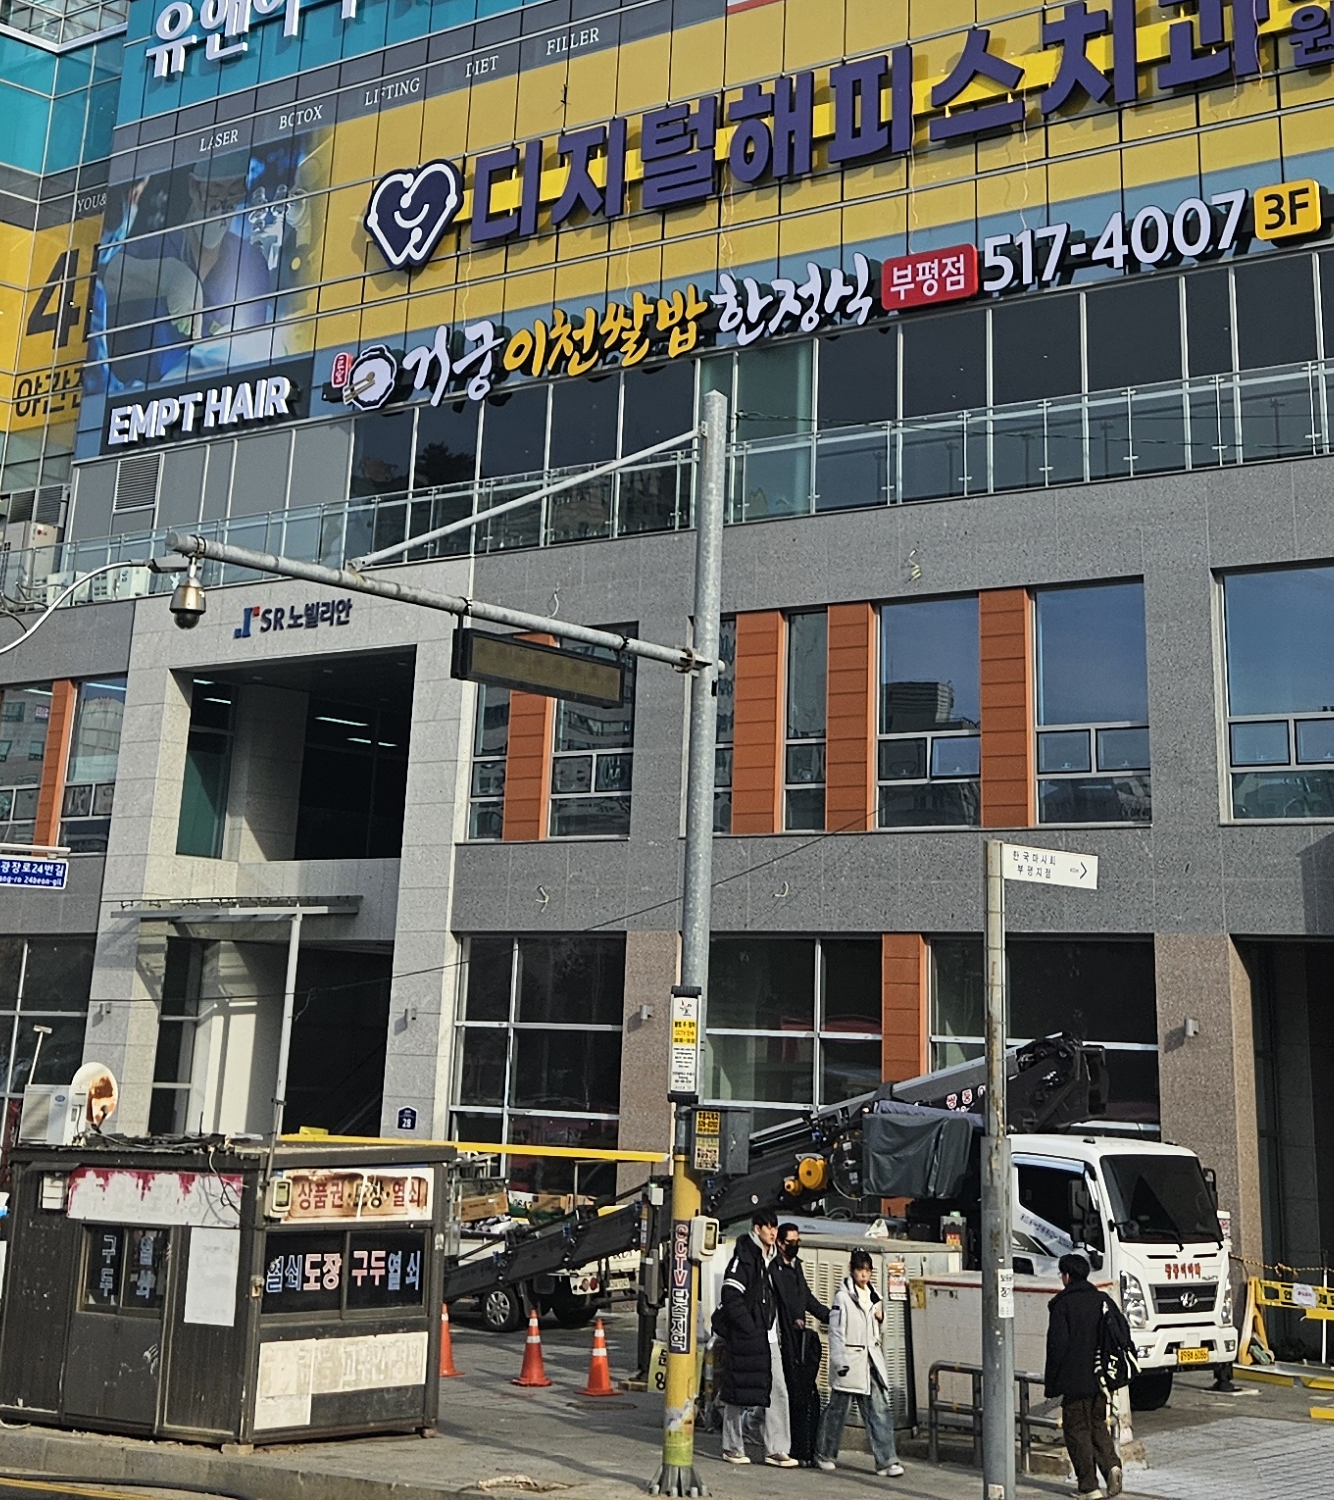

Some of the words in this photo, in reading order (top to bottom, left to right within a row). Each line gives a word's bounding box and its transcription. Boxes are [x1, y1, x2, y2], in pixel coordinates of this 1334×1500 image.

[199, 129, 240, 153] LASER
[278, 104, 324, 130] BOTOX
[545, 27, 601, 57] FILLER
[503, 283, 708, 378] 이천쌀밥
[709, 252, 874, 345] 한정식
[888, 254, 966, 298] 부평점
[984, 189, 1248, 292] 517-4007
[1262, 186, 1311, 231] 3F
[108, 391, 201, 446] EMPT
[203, 375, 291, 428] HAIR
[260, 608, 285, 633] SR
[288, 598, 354, 630] 노빌리안
[0, 861, 64, 877] 광장로24번길
[24, 876, 62, 886] 24beon-gil
[1013, 850, 1056, 866] 한국마사회
[1017, 864, 1051, 879] 부평지점
[298, 1180, 344, 1210] 상품권
[392, 1180, 422, 1208] 열쇠
[99, 1234, 117, 1297] 구두
[674, 1224, 689, 1287] CCTV
[670, 1288, 689, 1350] 단속지역
